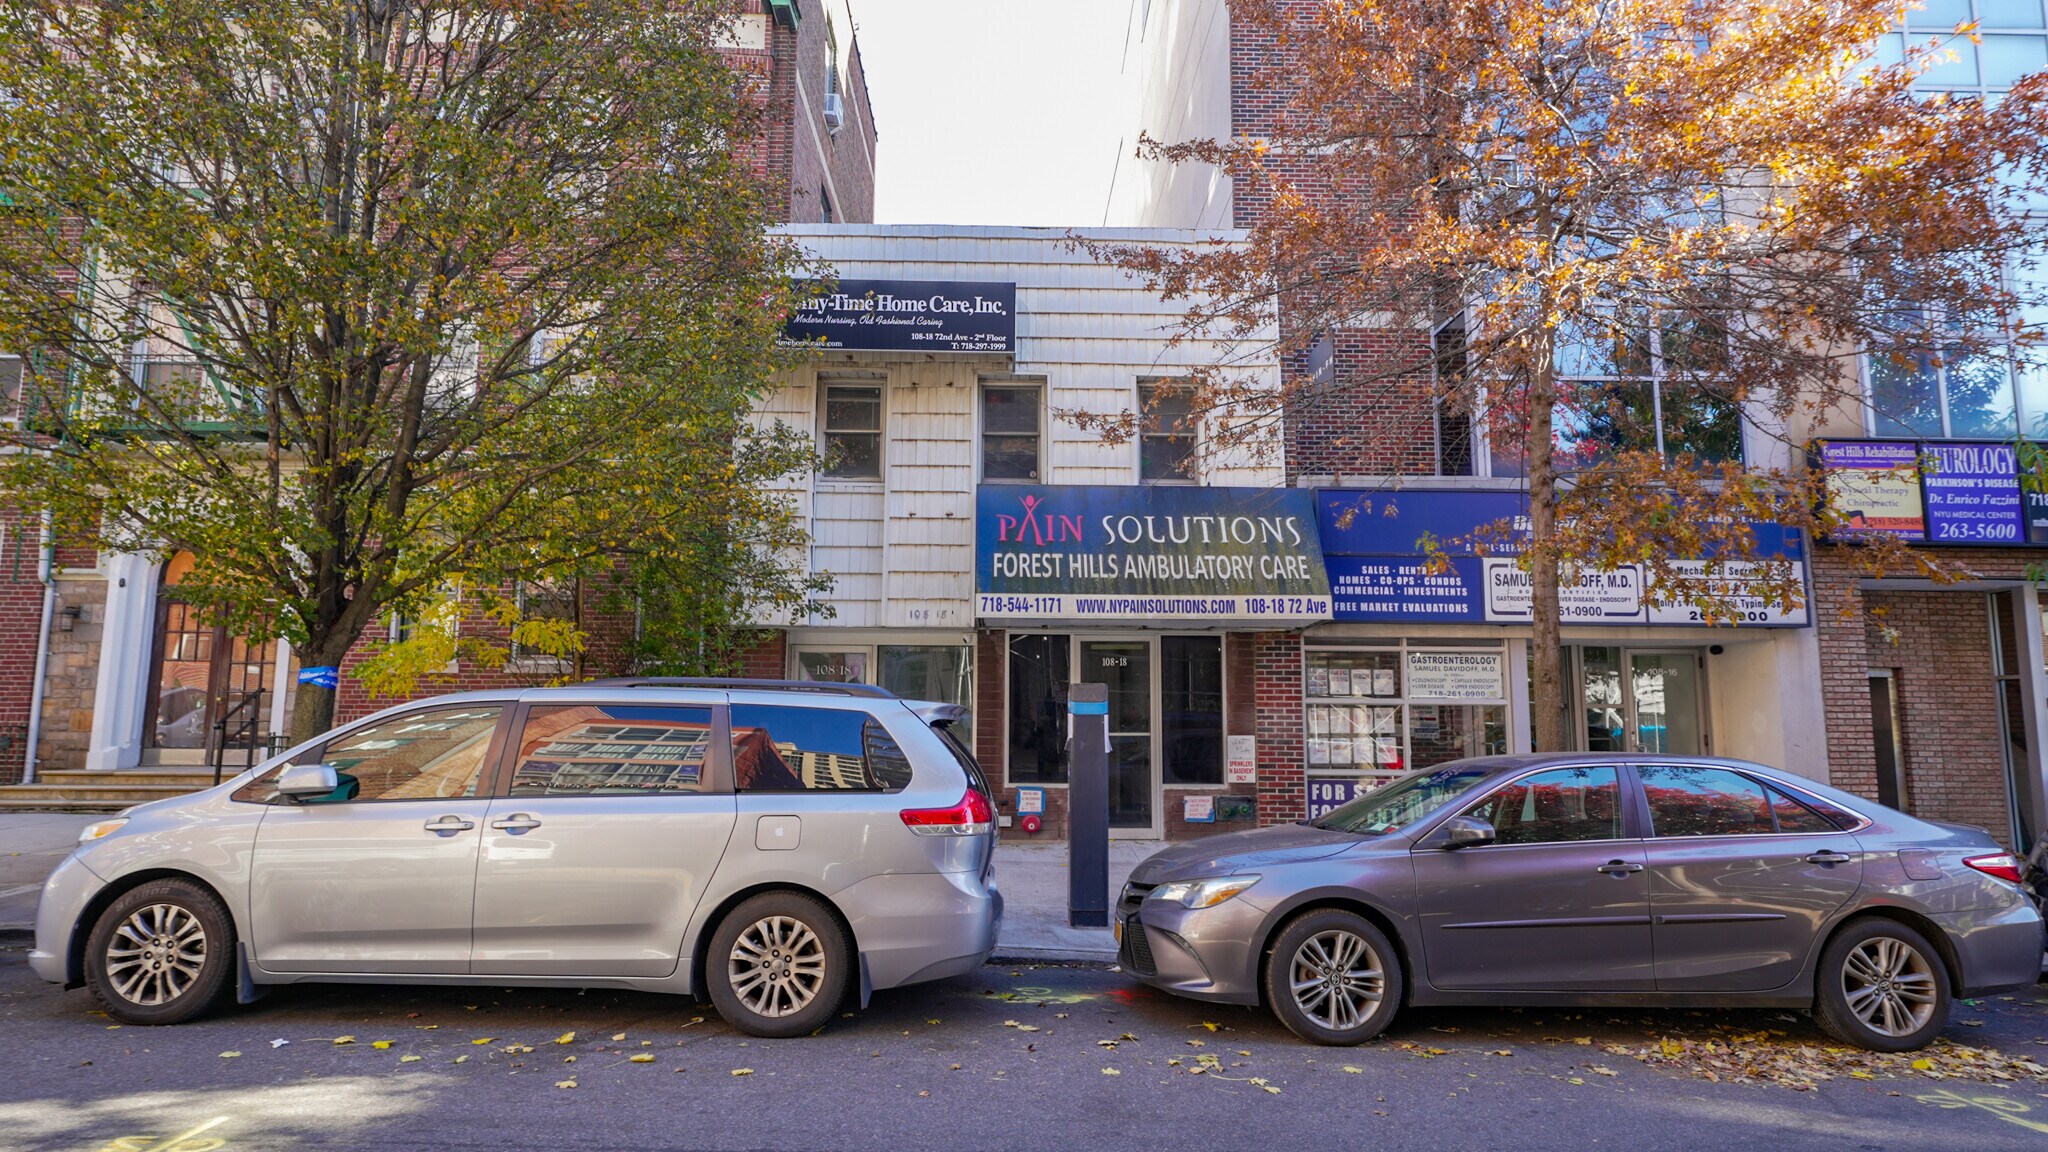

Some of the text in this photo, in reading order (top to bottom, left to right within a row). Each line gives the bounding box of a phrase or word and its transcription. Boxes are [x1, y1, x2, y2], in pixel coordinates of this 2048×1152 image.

[877, 294, 927, 312] Home
[929, 295, 974, 316] Care,
[974, 296, 1006, 316] Inc.
[793, 314, 943, 329] Modern Nursing, Old Fashioned Caring
[911, 332, 934, 341] 108-18
[935, 333, 952, 341] 72nd
[986, 334, 1006, 342] Floor
[951, 342, 960, 350] T:
[1823, 446, 1917, 458] Forest Hills Rehabilitation
[1926, 478, 2020, 488] PARKINSON'S DISEASE
[1875, 486, 1910, 497] Therapy
[1847, 499, 1900, 508] Chiropractic
[1929, 493, 2020, 506] Dr. Enrico Fazzini
[996, 494, 1301, 546] PAIN SOLUTIONS
[1952, 511, 1986, 519] MEDICAL
[1986, 511, 2016, 519] CENTER
[1939, 523, 2017, 539] 263-5600
[993, 553, 1311, 580] FOREST HILLS AMBULATORY CARE
[1361, 565, 1438, 576] SALES RENTAS
[1339, 576, 1462, 586] HOMES CO-OPS CONDOS
[1494, 573, 1534, 587] SAMUE
[1607, 574, 1632, 588] M.D.
[1333, 586, 1468, 597] COMMERCIAL INVESTMENTS
[981, 596, 1327, 614] 718-544-1171 WWW.NYPAINSOLUTIONS.COM 108-18 72 Ave
[1334, 602, 1469, 613] FREE MARKET EVALUATIONS
[1740, 599, 1768, 610] Typing
[1102, 657, 1128, 667] 108-18
[1411, 656, 1497, 665] GASTROENTEROLOGY
[1444, 665, 1480, 673] DAVIDOFF,
[1311, 784, 1346, 801] FOR
[1311, 804, 1341, 822] FO
